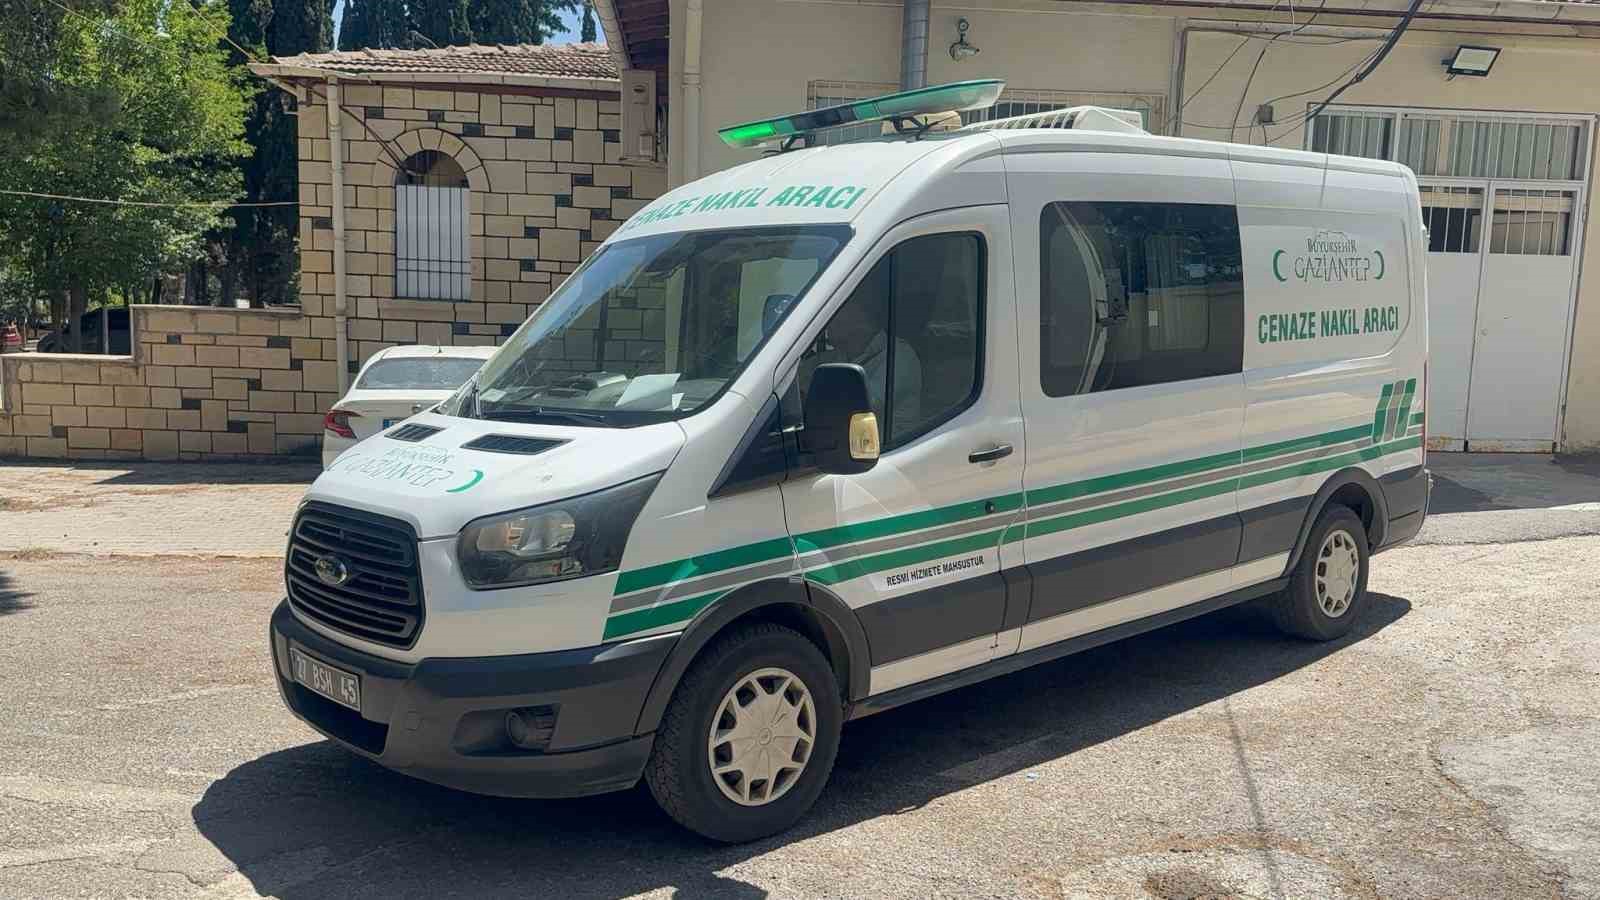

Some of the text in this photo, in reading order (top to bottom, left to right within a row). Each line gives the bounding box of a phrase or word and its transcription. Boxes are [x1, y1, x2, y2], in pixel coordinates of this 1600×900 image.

[766, 186, 866, 209] ARACI
[1258, 306, 1399, 343] CENAZE NAKİL ARACI
[886, 555, 985, 586] RESMİ HİZMETE MAHSUSTUR
[312, 663, 333, 695] BSH
[341, 676, 357, 705] 45
